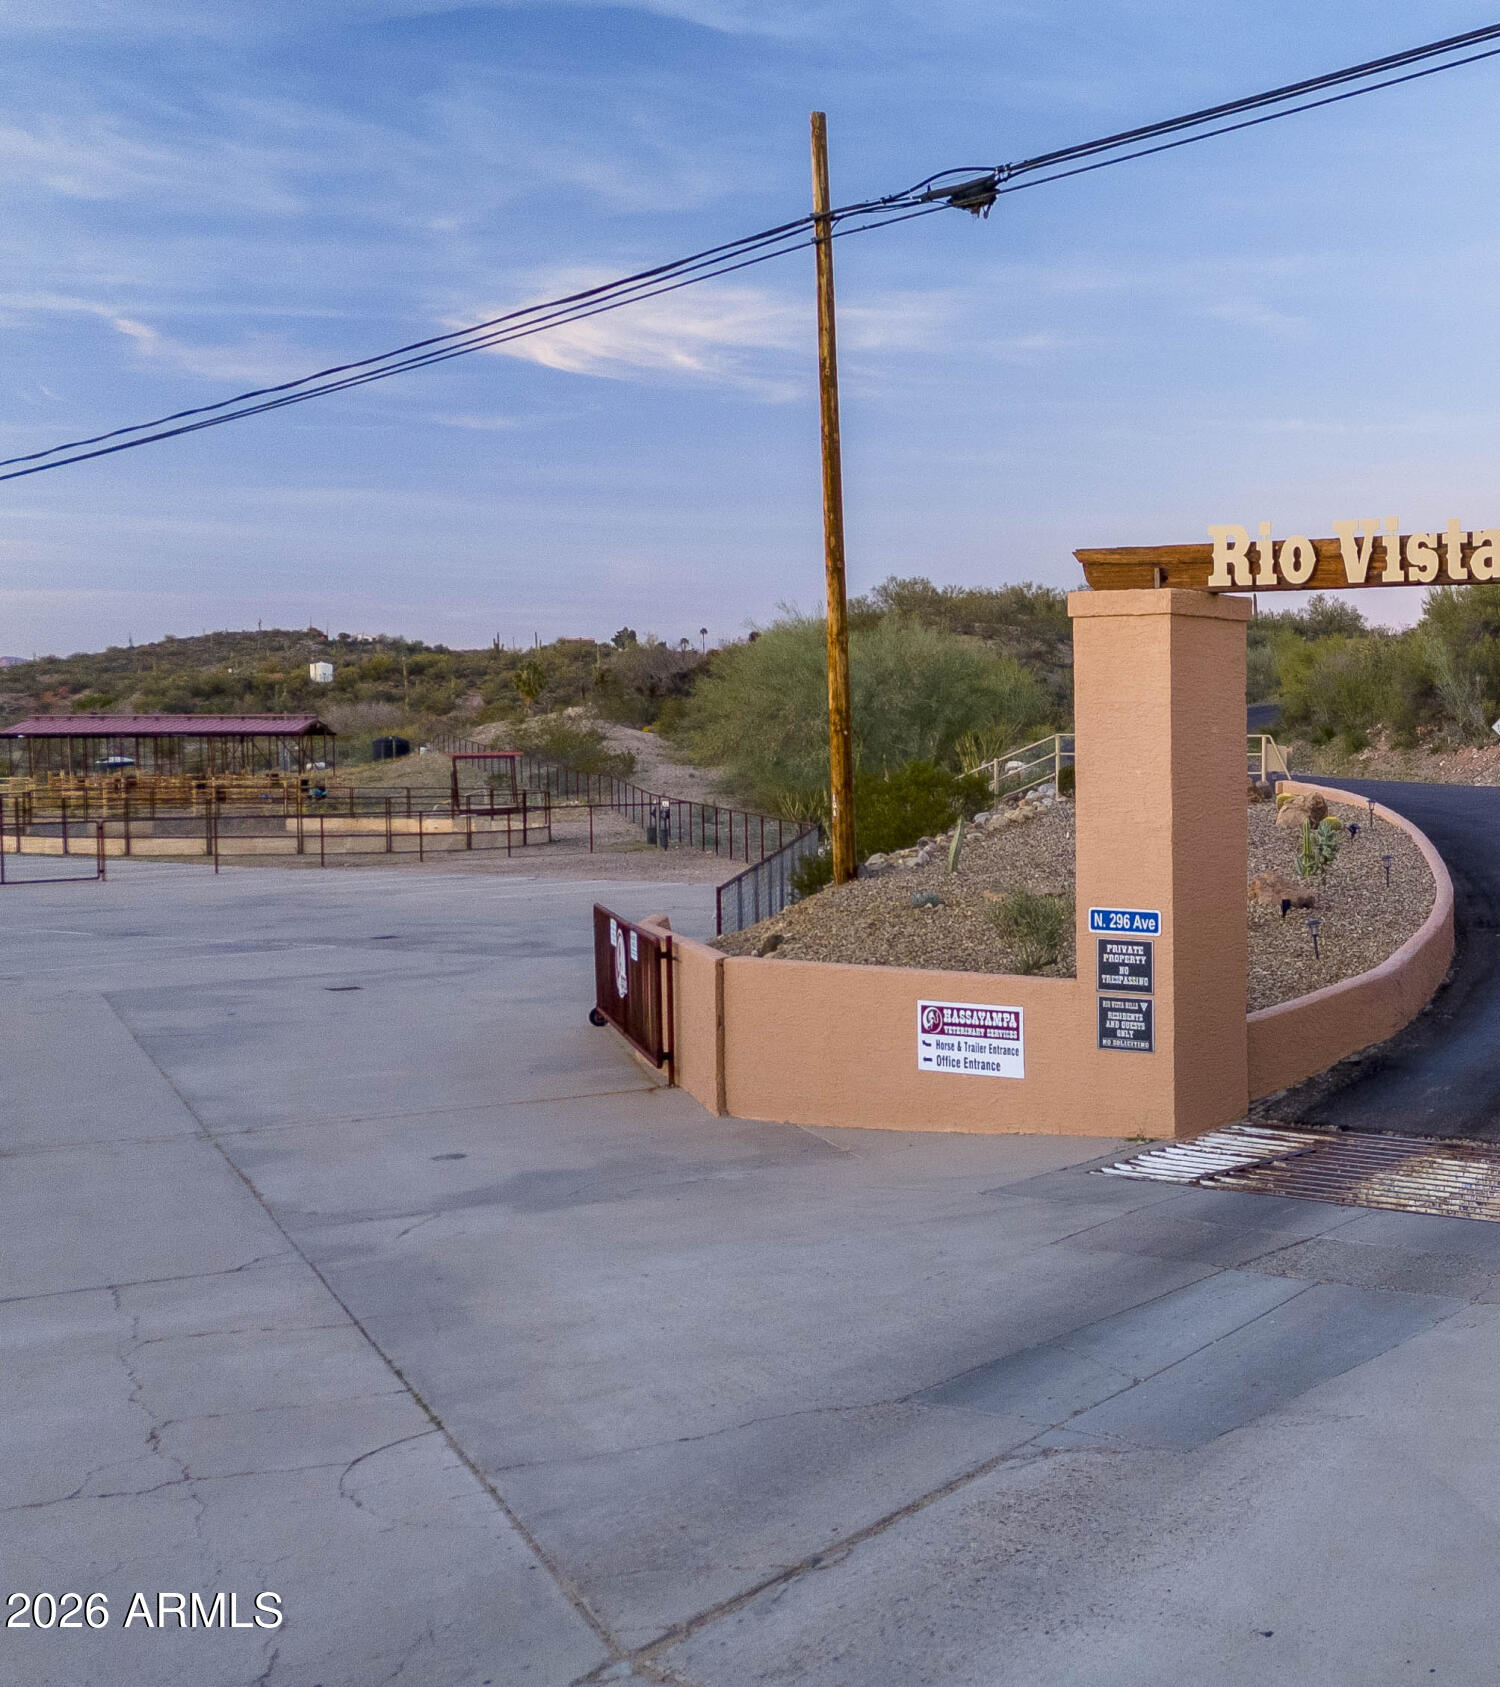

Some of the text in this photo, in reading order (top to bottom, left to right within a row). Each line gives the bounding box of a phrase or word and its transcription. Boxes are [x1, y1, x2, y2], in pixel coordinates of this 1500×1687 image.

[1207, 520, 1317, 587] Rio
[1094, 912, 1156, 930] N. 296 Ave
[1106, 944, 1144, 955] PRIVATE
[1103, 953, 1146, 965] PROPERTY
[1119, 966, 1129, 975] NO
[1101, 974, 1149, 986] TRESPASSING
[943, 1008, 1017, 1028] HASSAYAMPA
[1107, 1011, 1144, 1021] RESIDENTS
[1105, 1020, 1146, 1031] AND GUESTS
[943, 1026, 1017, 1039] VETERINARY SERVICES
[1116, 1029, 1134, 1039] ONLY
[935, 1040, 1020, 1057] Horse & Trailer Entrance
[936, 1055, 1001, 1072] Office Entrance
